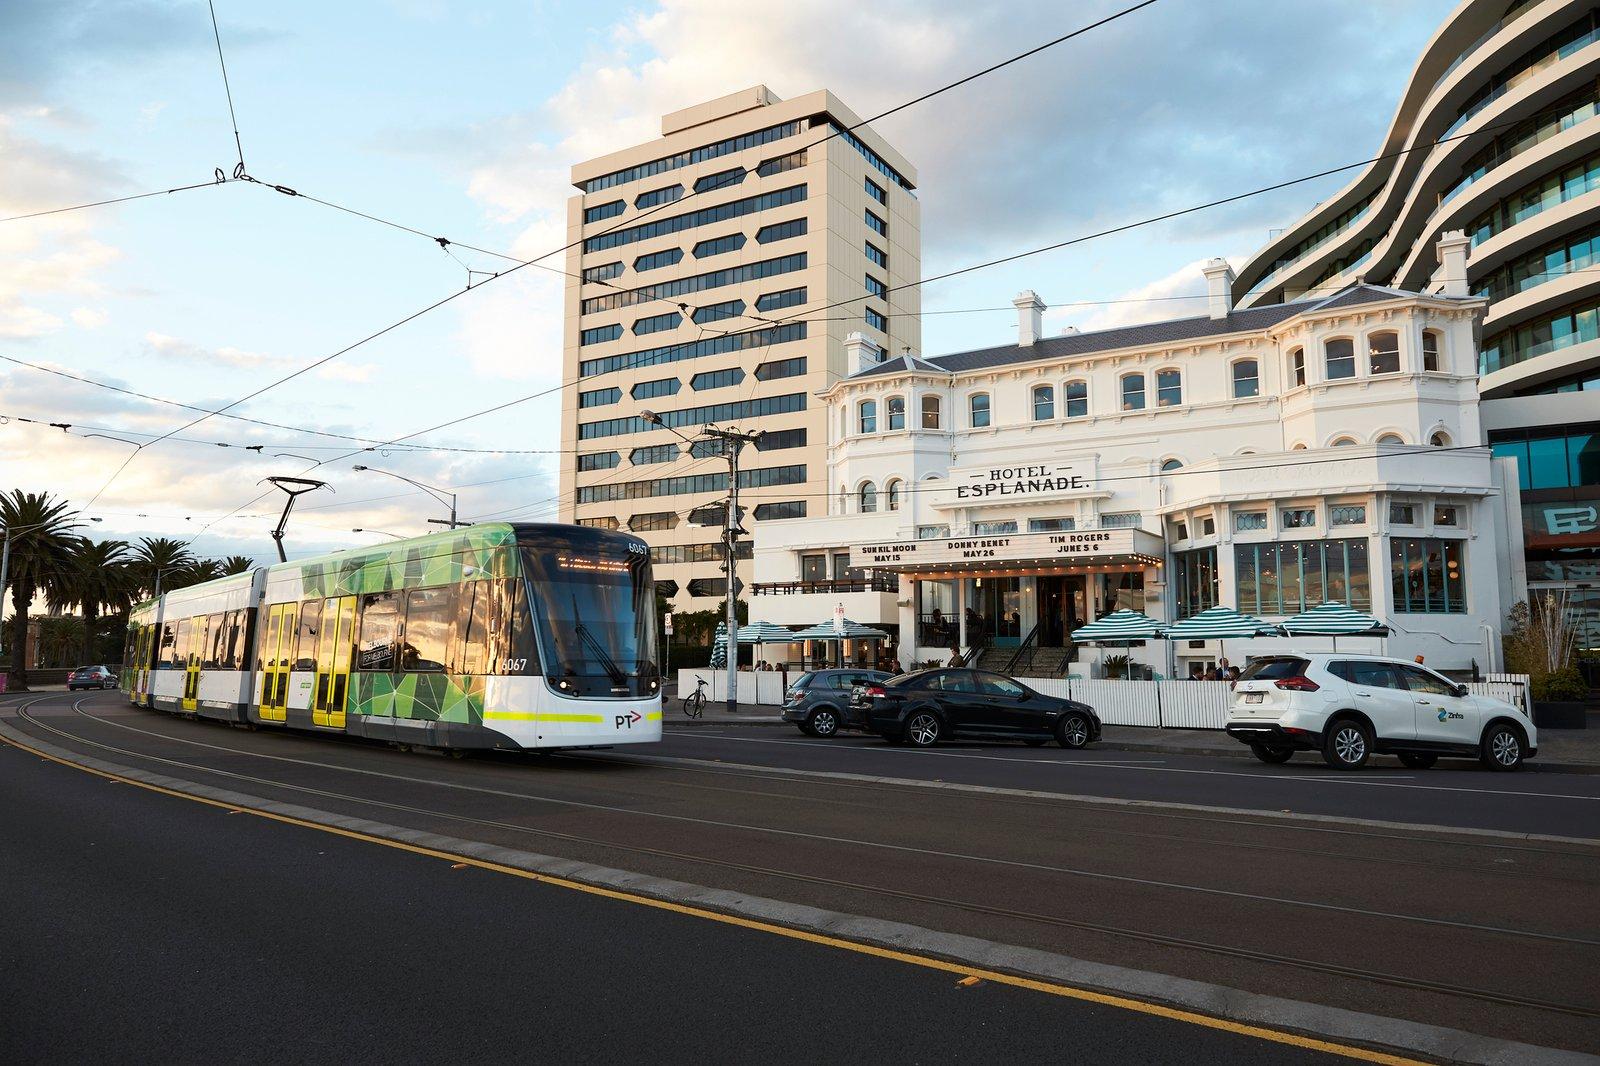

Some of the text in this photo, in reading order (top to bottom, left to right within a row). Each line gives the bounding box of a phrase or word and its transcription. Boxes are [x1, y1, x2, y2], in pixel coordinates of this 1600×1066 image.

[989, 466, 1051, 481] HOTEL
[1070, 533, 1110, 542] ROGERS
[628, 542, 647, 556] 6067
[948, 539, 1010, 549] DONNY BENET
[1057, 545, 1081, 553] JUNE
[1083, 544, 1089, 552] 5
[963, 550, 981, 558] MAY
[502, 659, 527, 671] 6067
